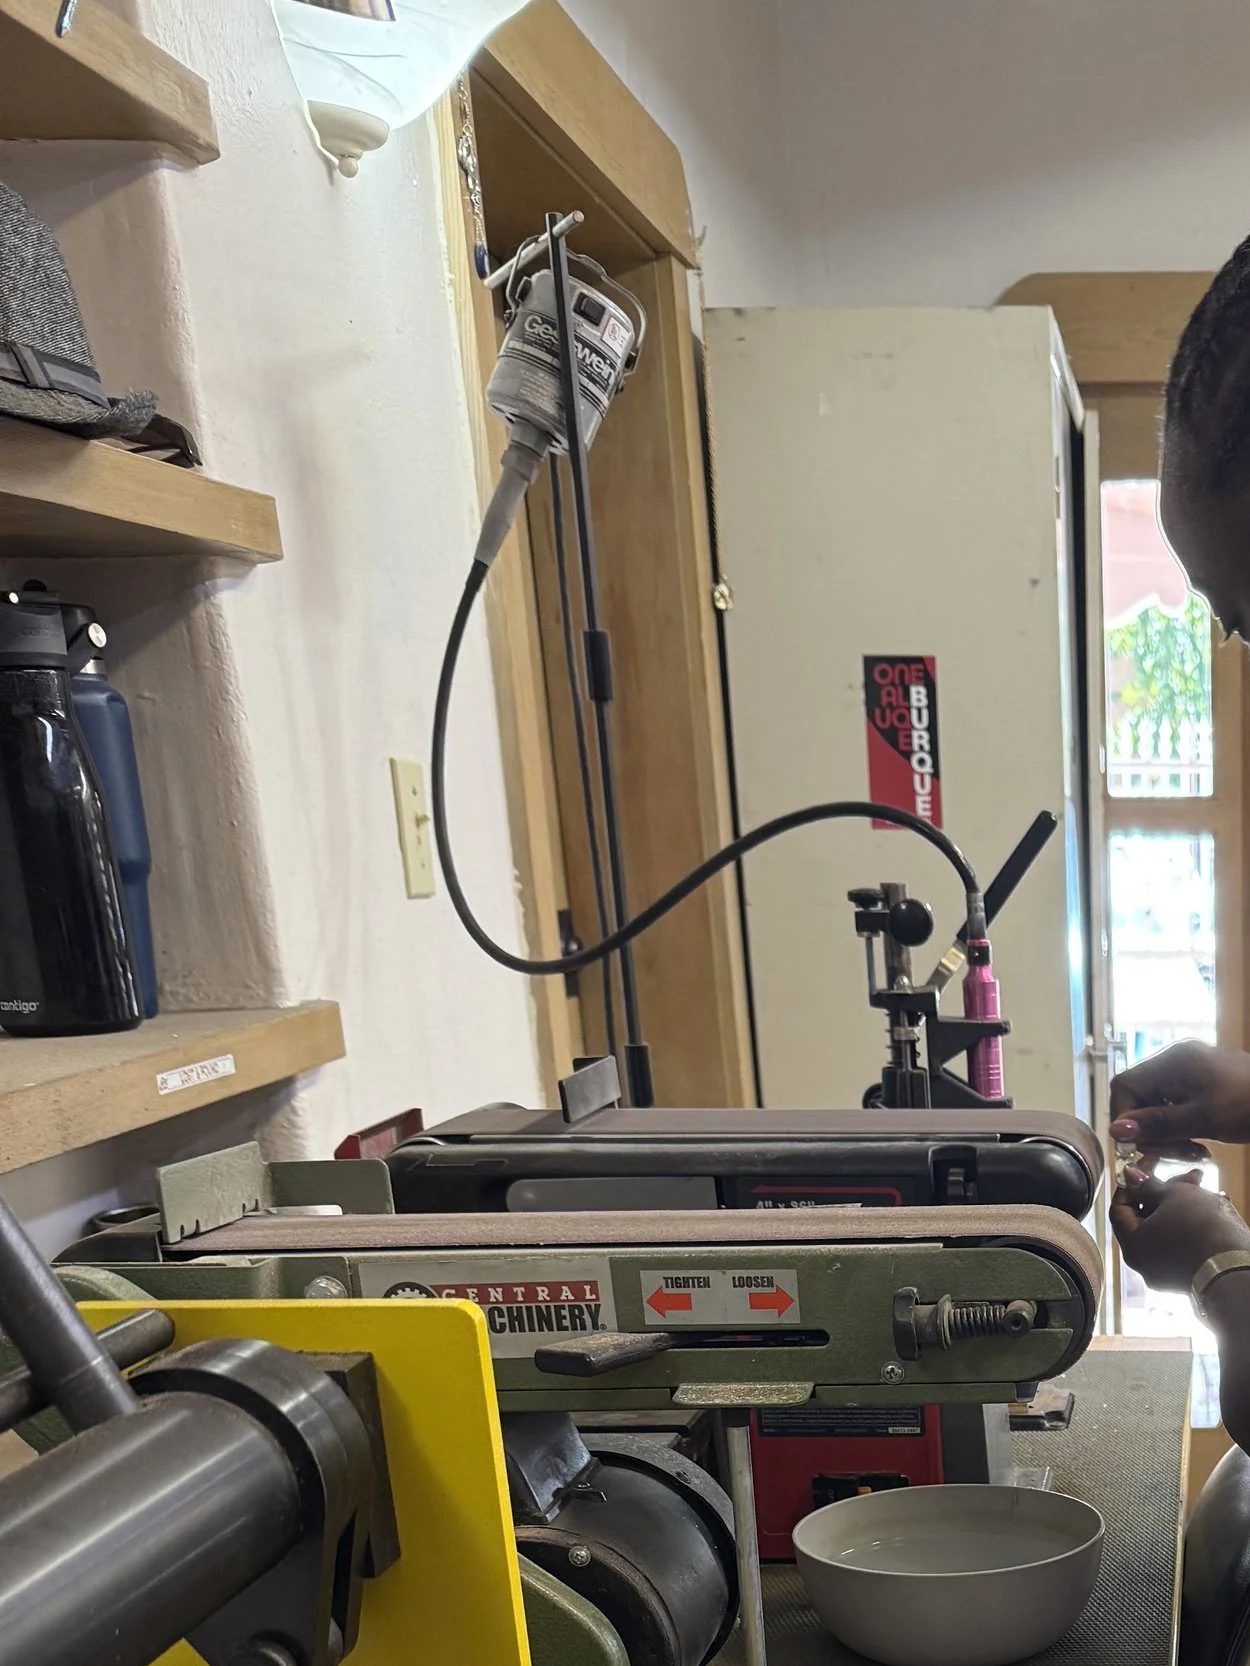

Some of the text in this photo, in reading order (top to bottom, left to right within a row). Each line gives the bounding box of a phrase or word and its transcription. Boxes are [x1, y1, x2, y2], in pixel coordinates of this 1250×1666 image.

[873, 663, 924, 686] ONE
[663, 1275, 775, 1289] TIGHTEN LOOSEN
[441, 1285, 600, 1302] CENTRAL
[487, 1303, 602, 1333] CHINERY
